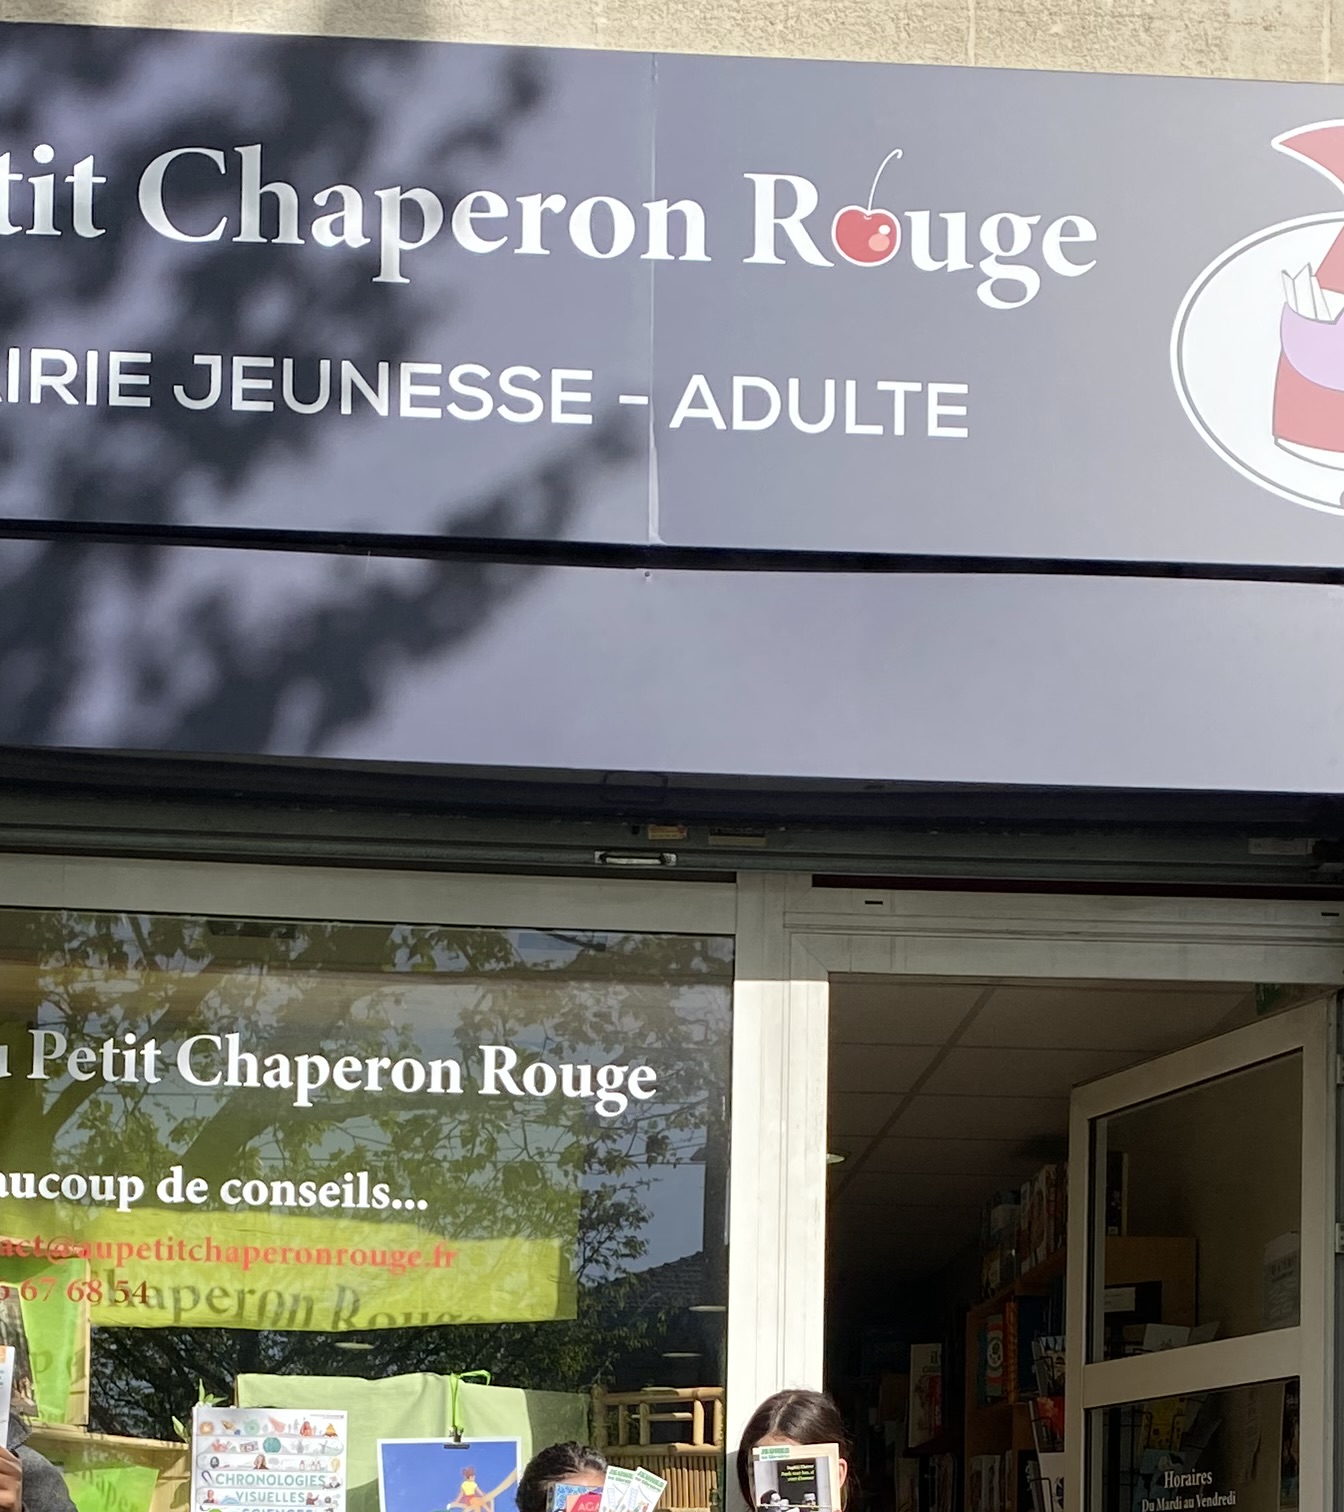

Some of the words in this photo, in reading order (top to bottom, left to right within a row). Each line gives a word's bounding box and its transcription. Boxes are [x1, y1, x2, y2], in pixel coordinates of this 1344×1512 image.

[137, 144, 713, 284] Chaperon
[743, 148, 1098, 309] Rouge
[173, 353, 594, 424] JEUNESSE
[669, 374, 969, 439] ADULTE
[25, 1029, 163, 1086] Petit
[176, 1033, 461, 1107] Chaperon
[479, 1044, 657, 1118] Rouge
[156, 1163, 209, 1205] de
[219, 1170, 429, 1213] conseils...
[20, 1277, 57, 1301] 67
[66, 1279, 103, 1302] 68
[114, 1279, 149, 1304] 54
[216, 1473, 326, 1487] CHRONOLOGIES
[1164, 1469, 1213, 1488] Horaires
[236, 1490, 305, 1503] VISUELLES
[1142, 1499, 1154, 1512] Du
[1156, 1496, 1182, 1511] Mardi
[1184, 1499, 1194, 1508] au
[1196, 1491, 1236, 1508] Vendredi
